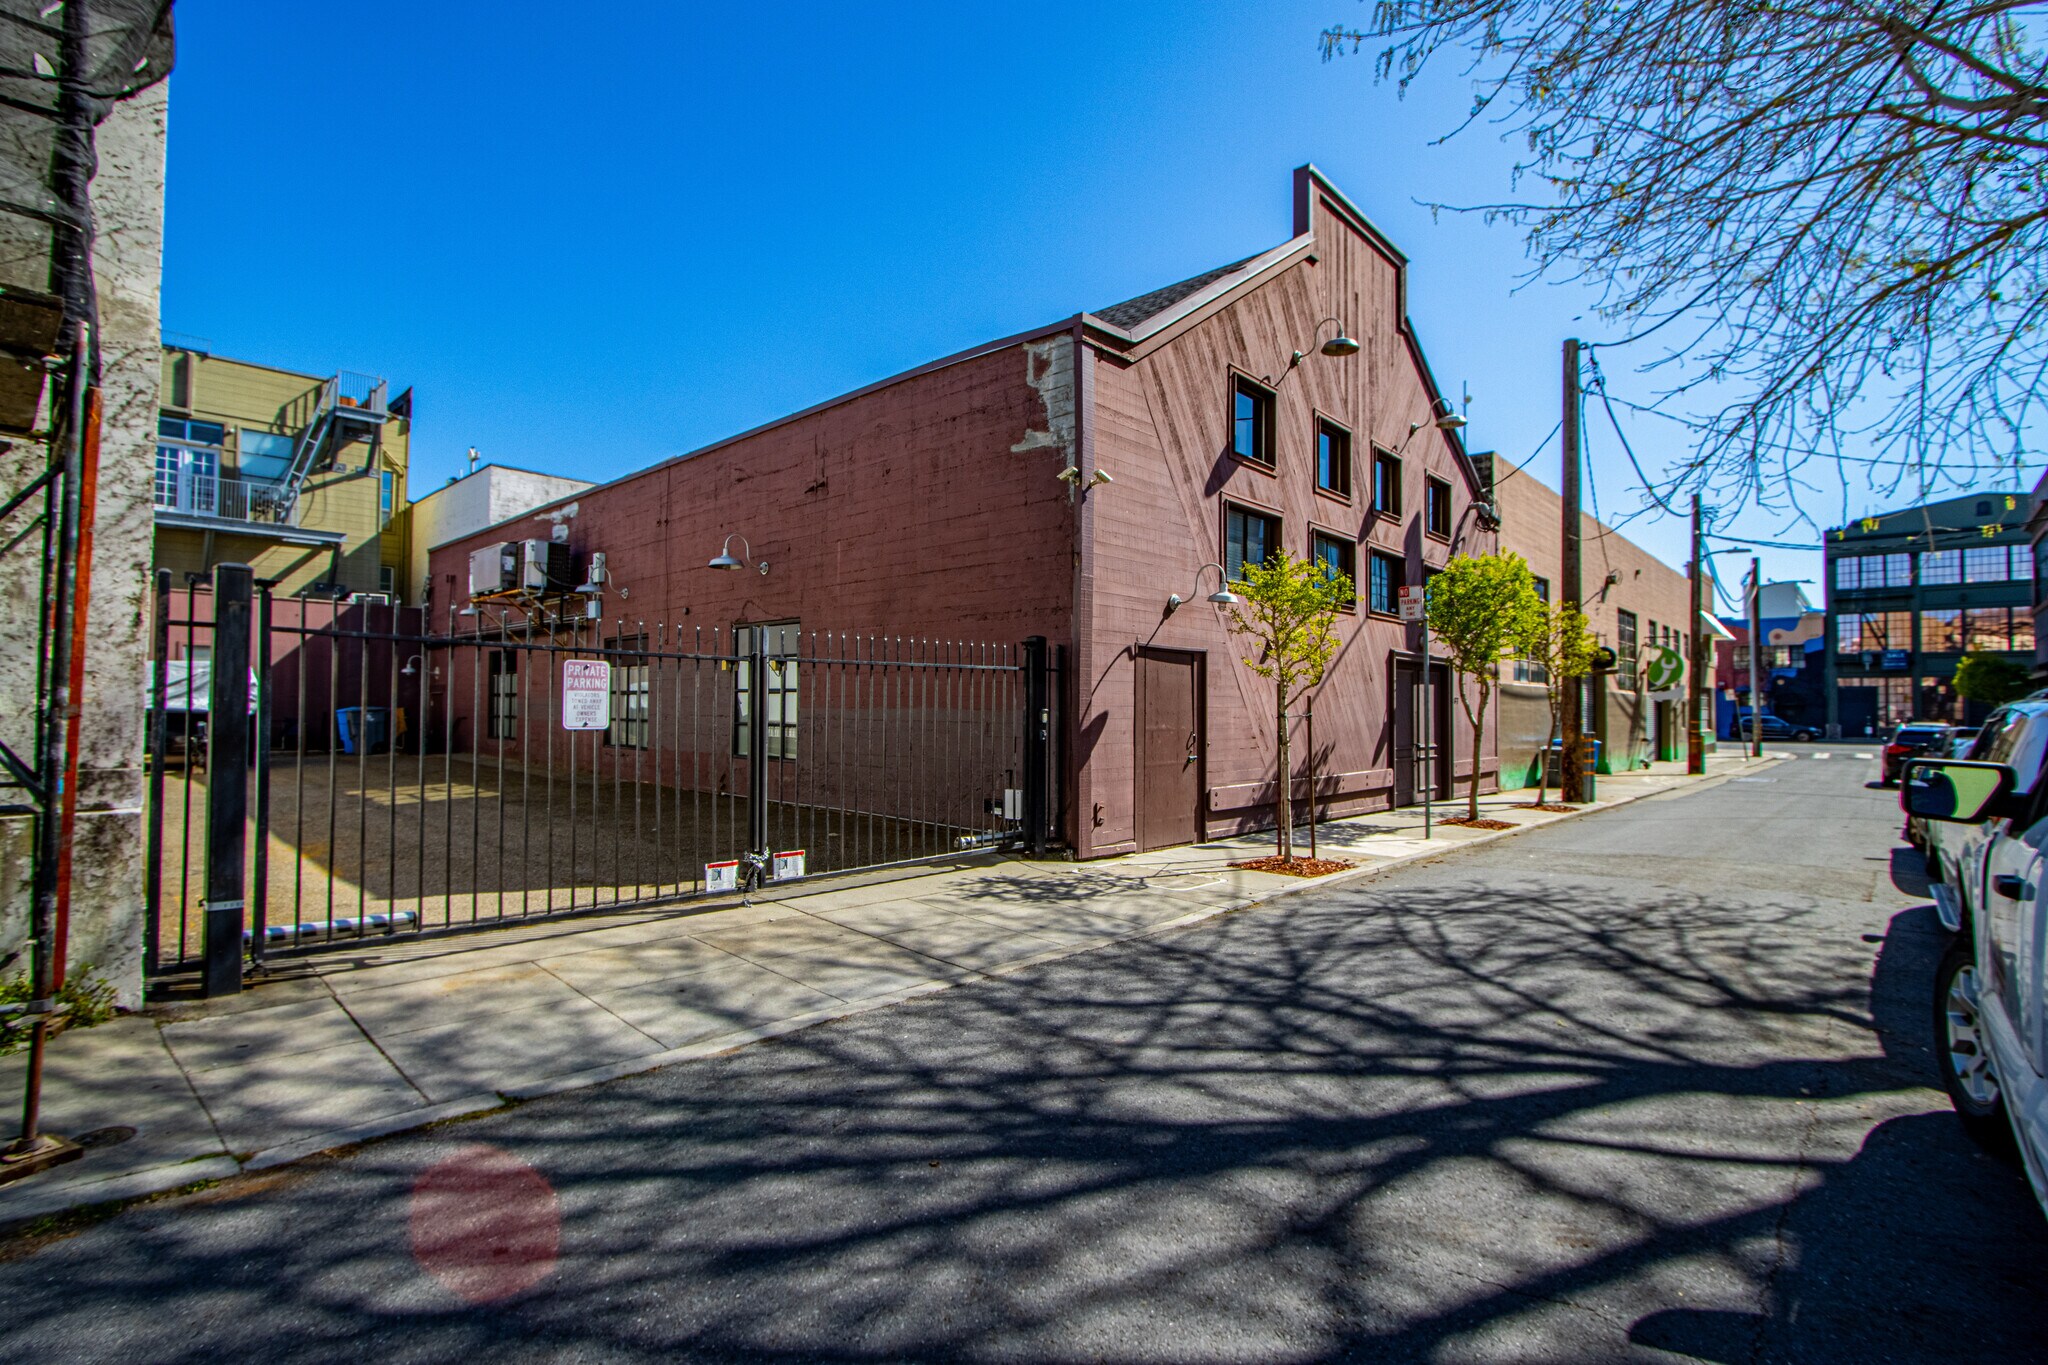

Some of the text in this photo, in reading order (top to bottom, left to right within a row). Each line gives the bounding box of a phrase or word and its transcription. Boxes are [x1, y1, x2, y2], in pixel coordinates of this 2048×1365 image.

[1400, 588, 1408, 596] NO
[568, 665, 606, 677] PRIVATE
[568, 678, 606, 689] PARKING
